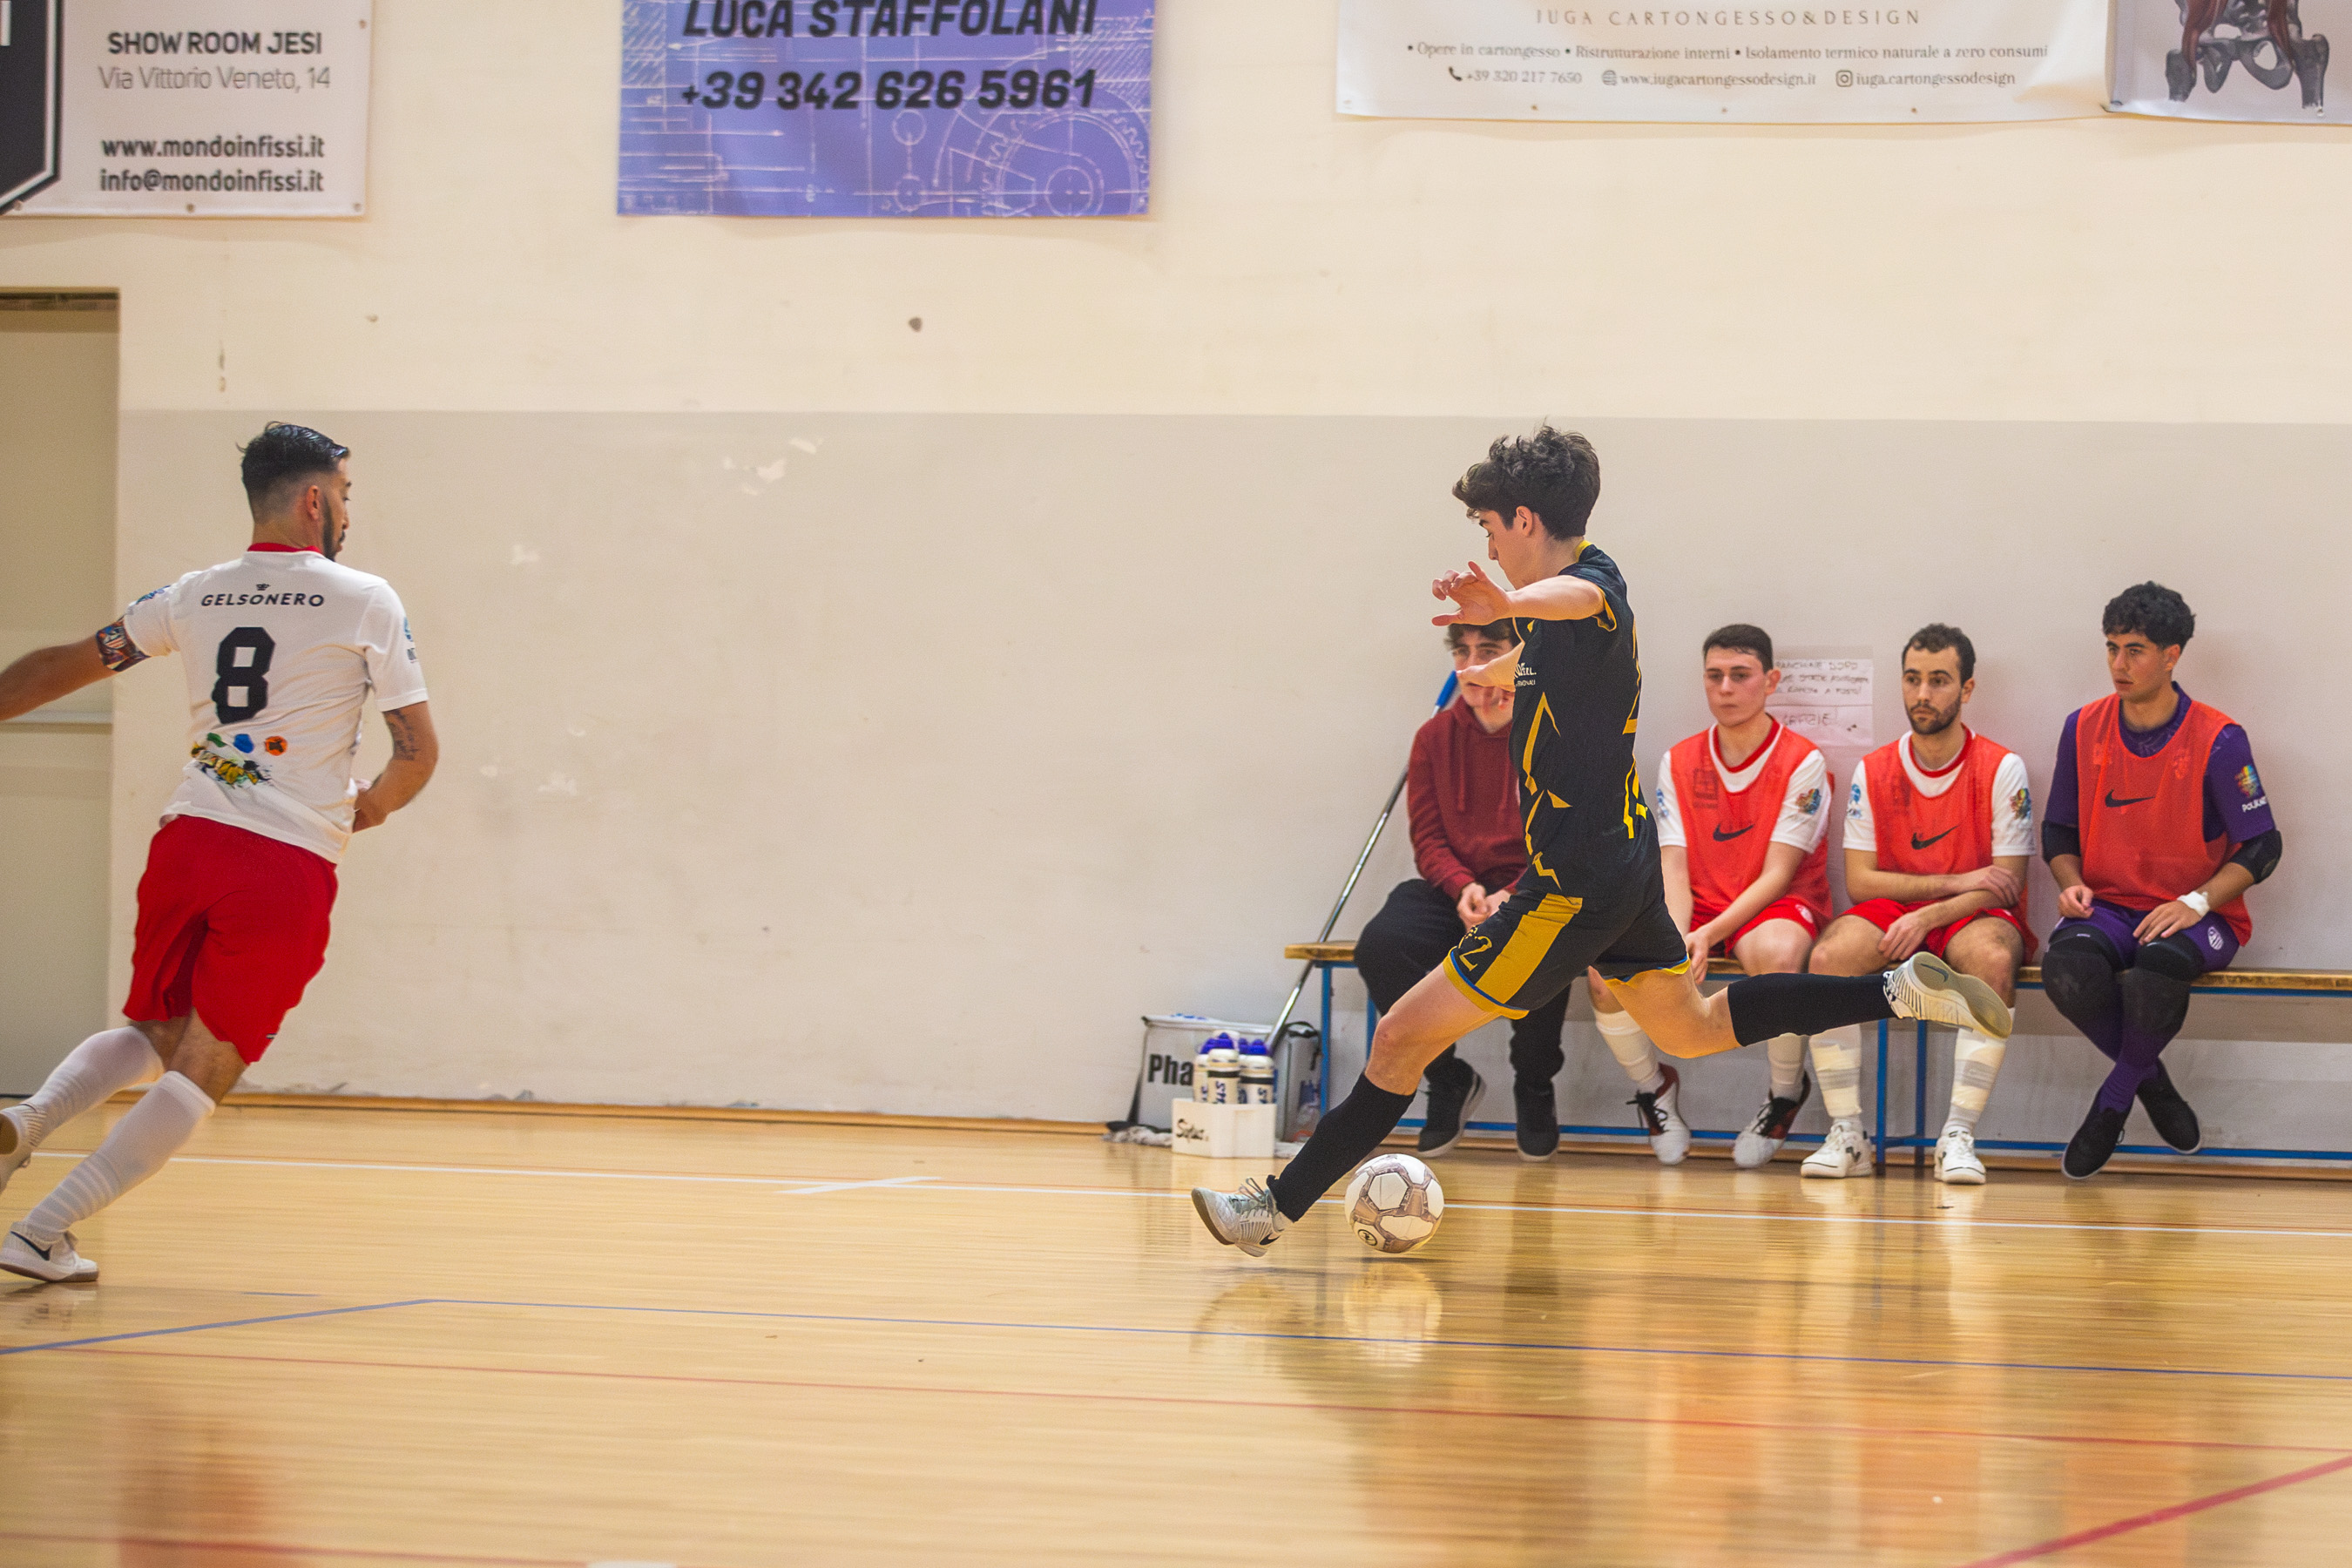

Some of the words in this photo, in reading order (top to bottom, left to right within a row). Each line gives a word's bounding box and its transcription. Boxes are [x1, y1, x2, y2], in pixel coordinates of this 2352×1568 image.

[682, 0, 794, 37] LUCA
[808, 0, 1098, 37] STAFFOLANI
[1608, 10, 1919, 26] CARTONGESSO&DESIGN
[107, 31, 182, 55] SHOW
[187, 31, 260, 55] ROOM
[267, 31, 322, 55] JESI
[1416, 42, 1457, 58] Opere
[1461, 44, 1474, 56] in
[1478, 44, 1561, 60] cartongesso
[1575, 45, 1680, 60] Ristrutturazione
[1684, 47, 1731, 60] interni
[1746, 45, 1821, 59] Isolamento
[1825, 45, 1879, 59] termico
[1882, 45, 1940, 58] naturale
[1943, 48, 1951, 58] a
[1955, 48, 1986, 58] zero
[1989, 45, 2049, 58] consumi
[98, 65, 133, 89] Via
[139, 65, 213, 89] Vittorio
[217, 66, 301, 93] Veneto,
[307, 66, 331, 88] 14
[1466, 70, 1490, 82] +39
[1492, 71, 1518, 83] 320
[1521, 71, 1546, 83] 217
[1551, 71, 1583, 84] 7650
[1620, 72, 1816, 89] www.iugacartongessodesign.it
[1856, 71, 2016, 88] iuga.cartongessodesign
[682, 71, 765, 109] +39
[777, 71, 862, 110] 342
[875, 70, 966, 109] 626
[977, 69, 1098, 109] 5961
[101, 135, 325, 159] www.mondoinfissi.it
[100, 169, 324, 193] info@mondoinfissi.it
[200, 592, 325, 607] GELSONERO
[211, 626, 276, 724] 8
